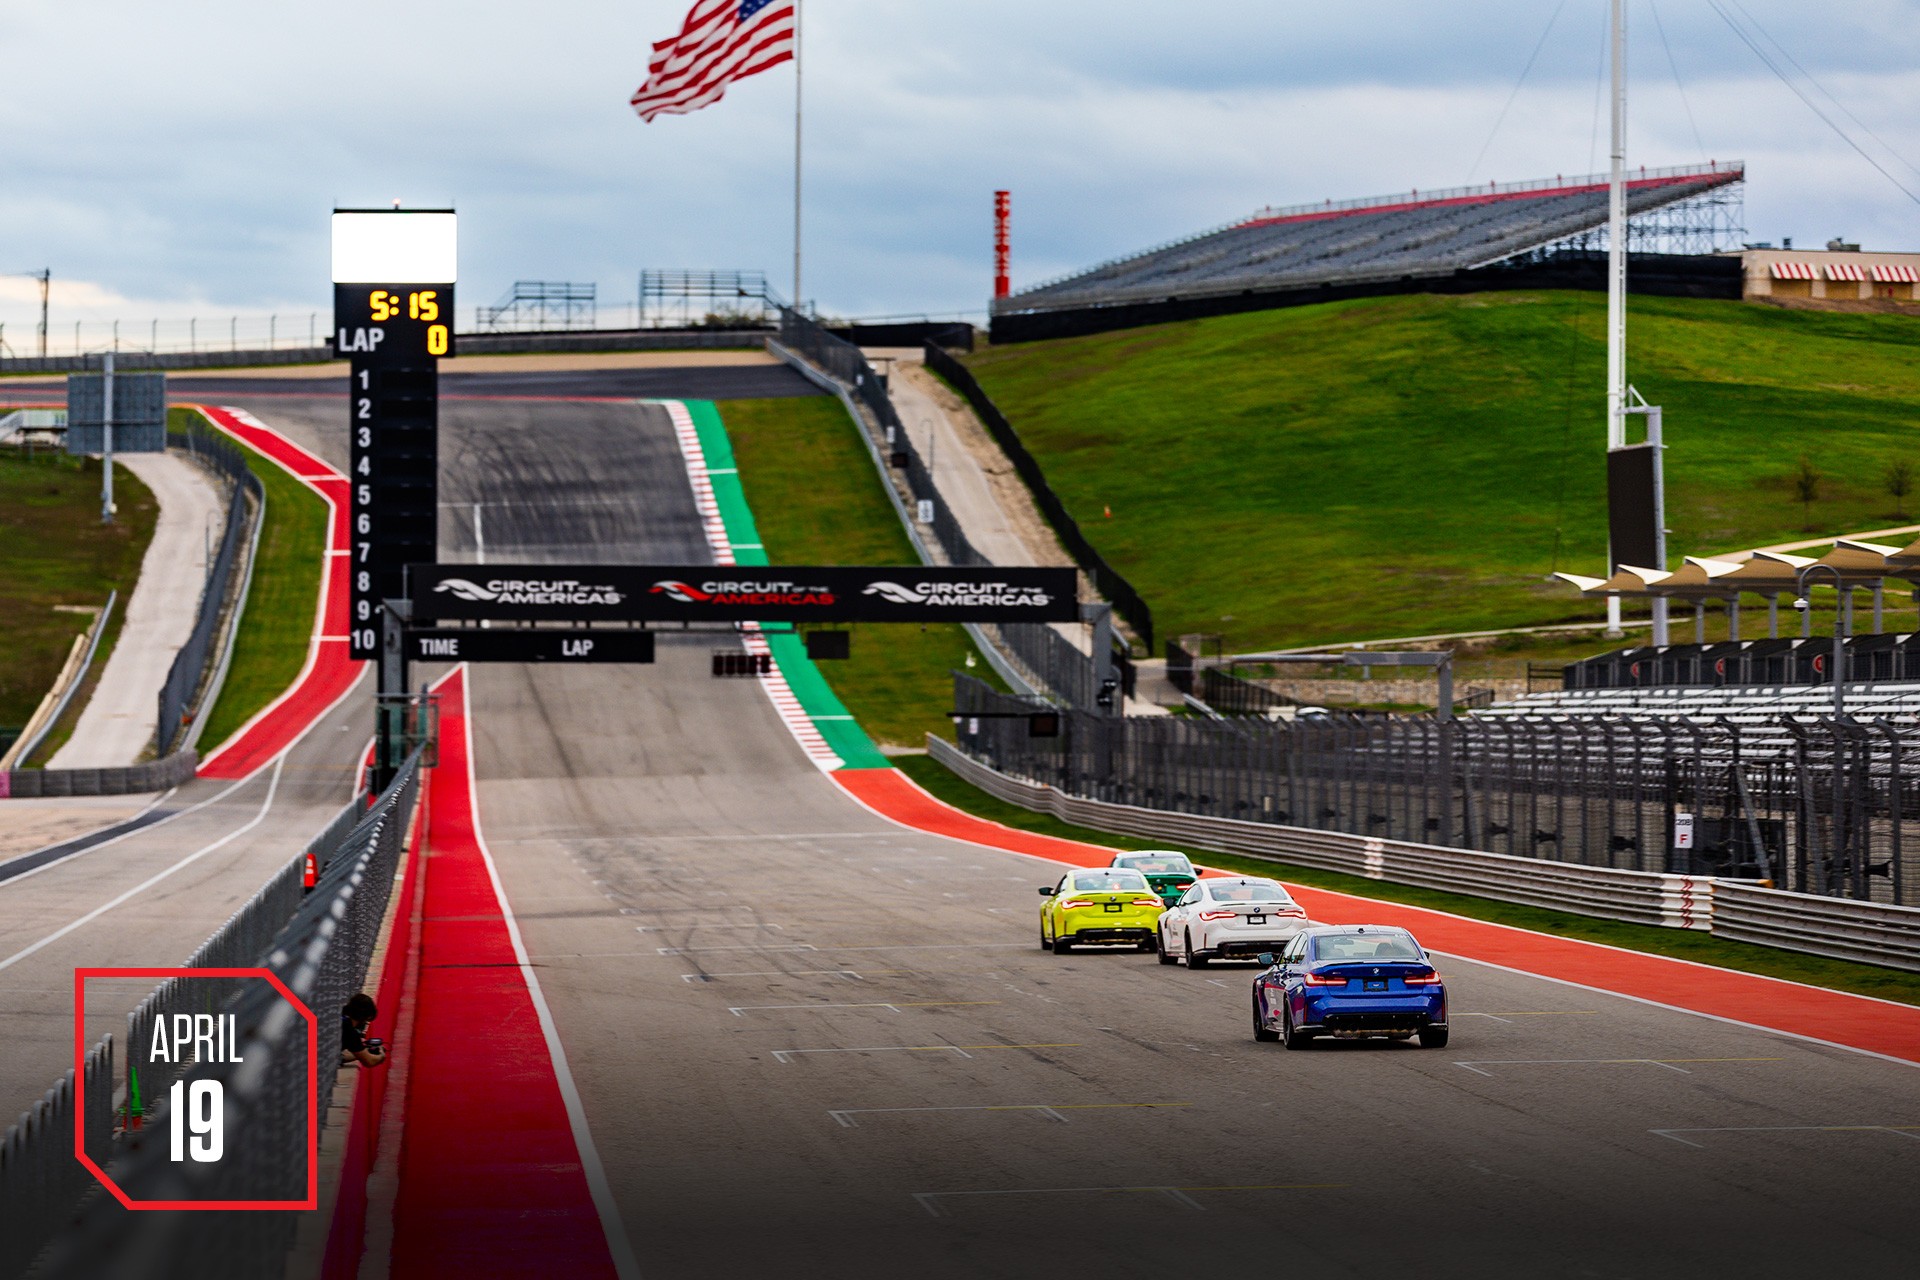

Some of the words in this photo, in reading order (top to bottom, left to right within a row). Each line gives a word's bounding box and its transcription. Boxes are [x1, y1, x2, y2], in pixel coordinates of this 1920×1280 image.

[369, 290, 439, 321] 5:15
[339, 328, 385, 352] LAP
[427, 324, 448, 355] 0
[358, 369, 369, 390] 1
[358, 398, 371, 419] 2
[358, 427, 371, 447] 3
[357, 456, 371, 476] 4
[358, 485, 371, 505] 5
[358, 514, 371, 534] 6
[358, 543, 371, 562] 7
[358, 572, 370, 592] 8
[486, 580, 579, 592] CIRCUIT
[701, 581, 793, 593] CIRCUIT
[915, 582, 1008, 594] CIRCUIT
[496, 592, 621, 604] AMERICAS
[711, 593, 835, 605] AMERICAS
[925, 594, 1049, 606] AMERICAS
[357, 600, 370, 620] 9
[352, 630, 375, 650] 10
[420, 639, 458, 656] TIME
[562, 640, 594, 656] LAP
[1680, 833, 1688, 844] F
